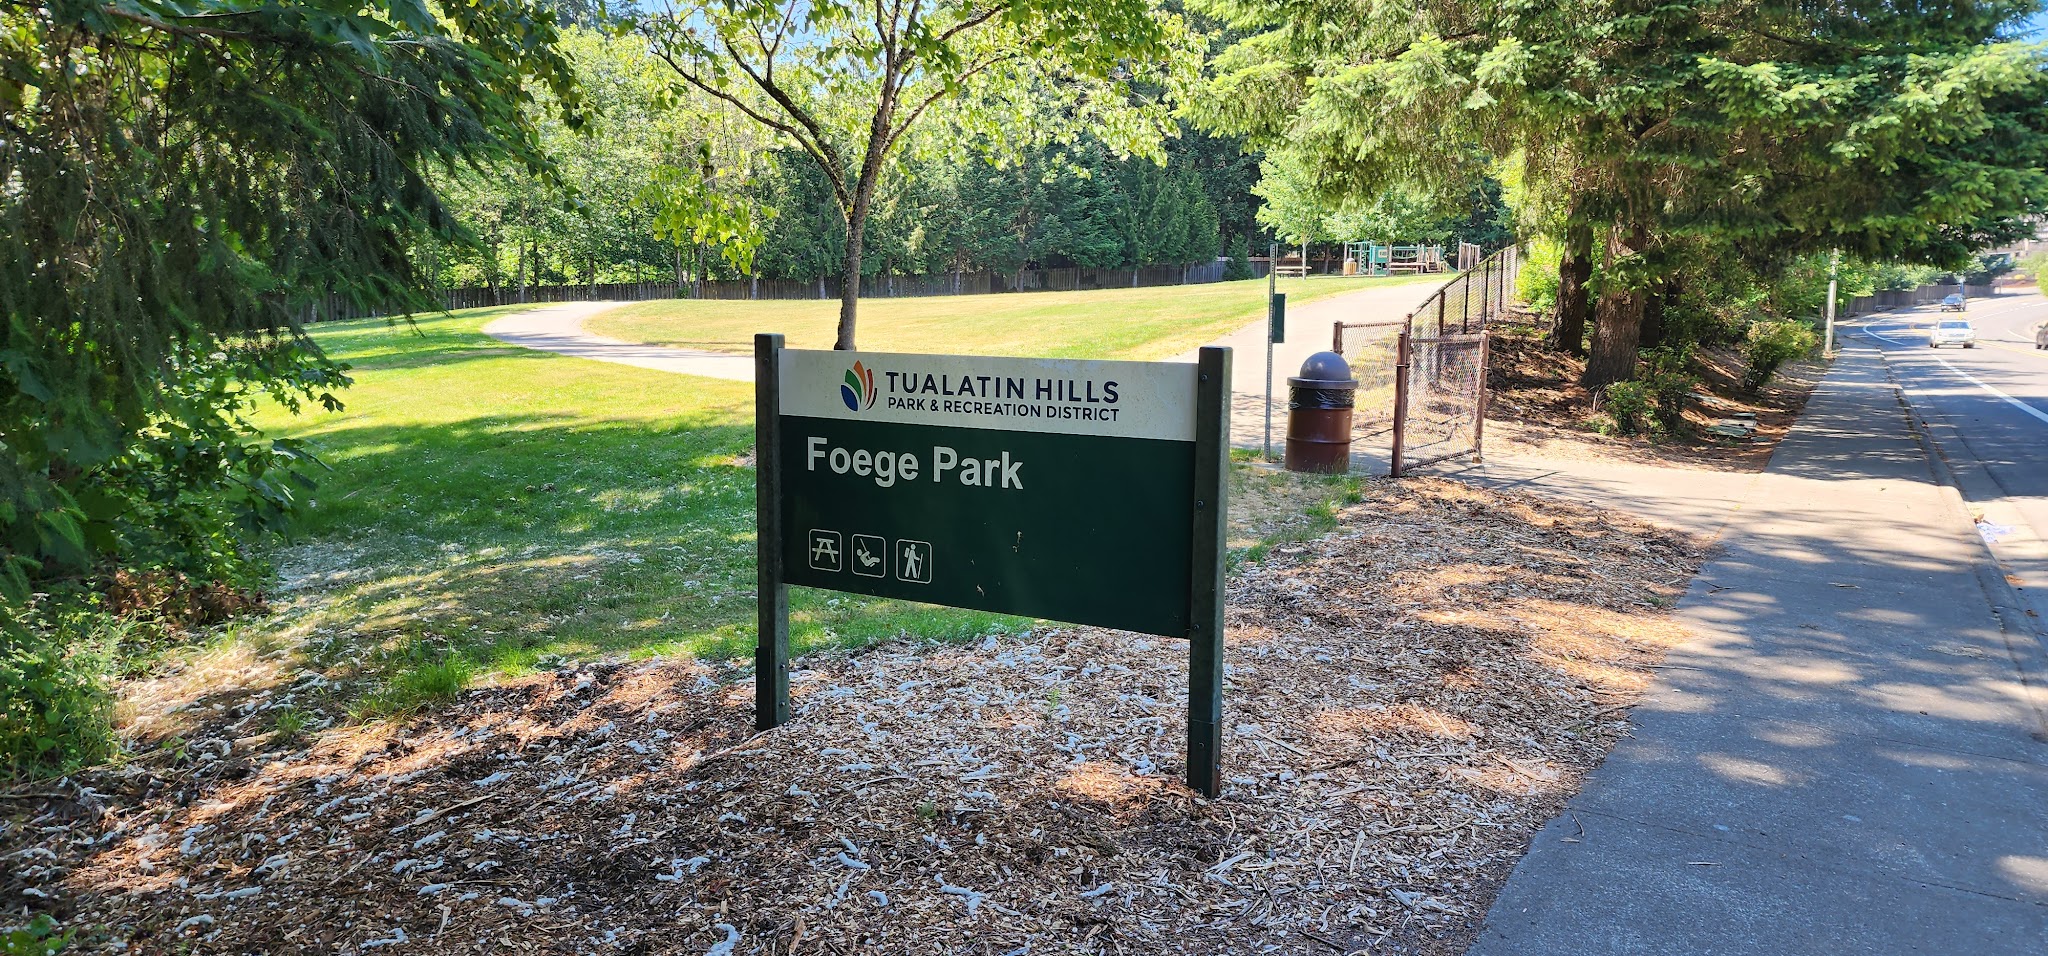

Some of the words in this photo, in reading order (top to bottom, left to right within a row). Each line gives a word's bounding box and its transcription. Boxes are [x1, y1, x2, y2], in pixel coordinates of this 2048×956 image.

[885, 371, 1025, 400] TUALATIN
[1035, 378, 1119, 404] HILLS
[887, 396, 926, 411] PARK
[929, 398, 940, 412] &
[943, 399, 1041, 418] RECREATION
[1046, 405, 1120, 422] DISTRICT
[807, 436, 919, 488] Foege
[933, 446, 1024, 490] Park
